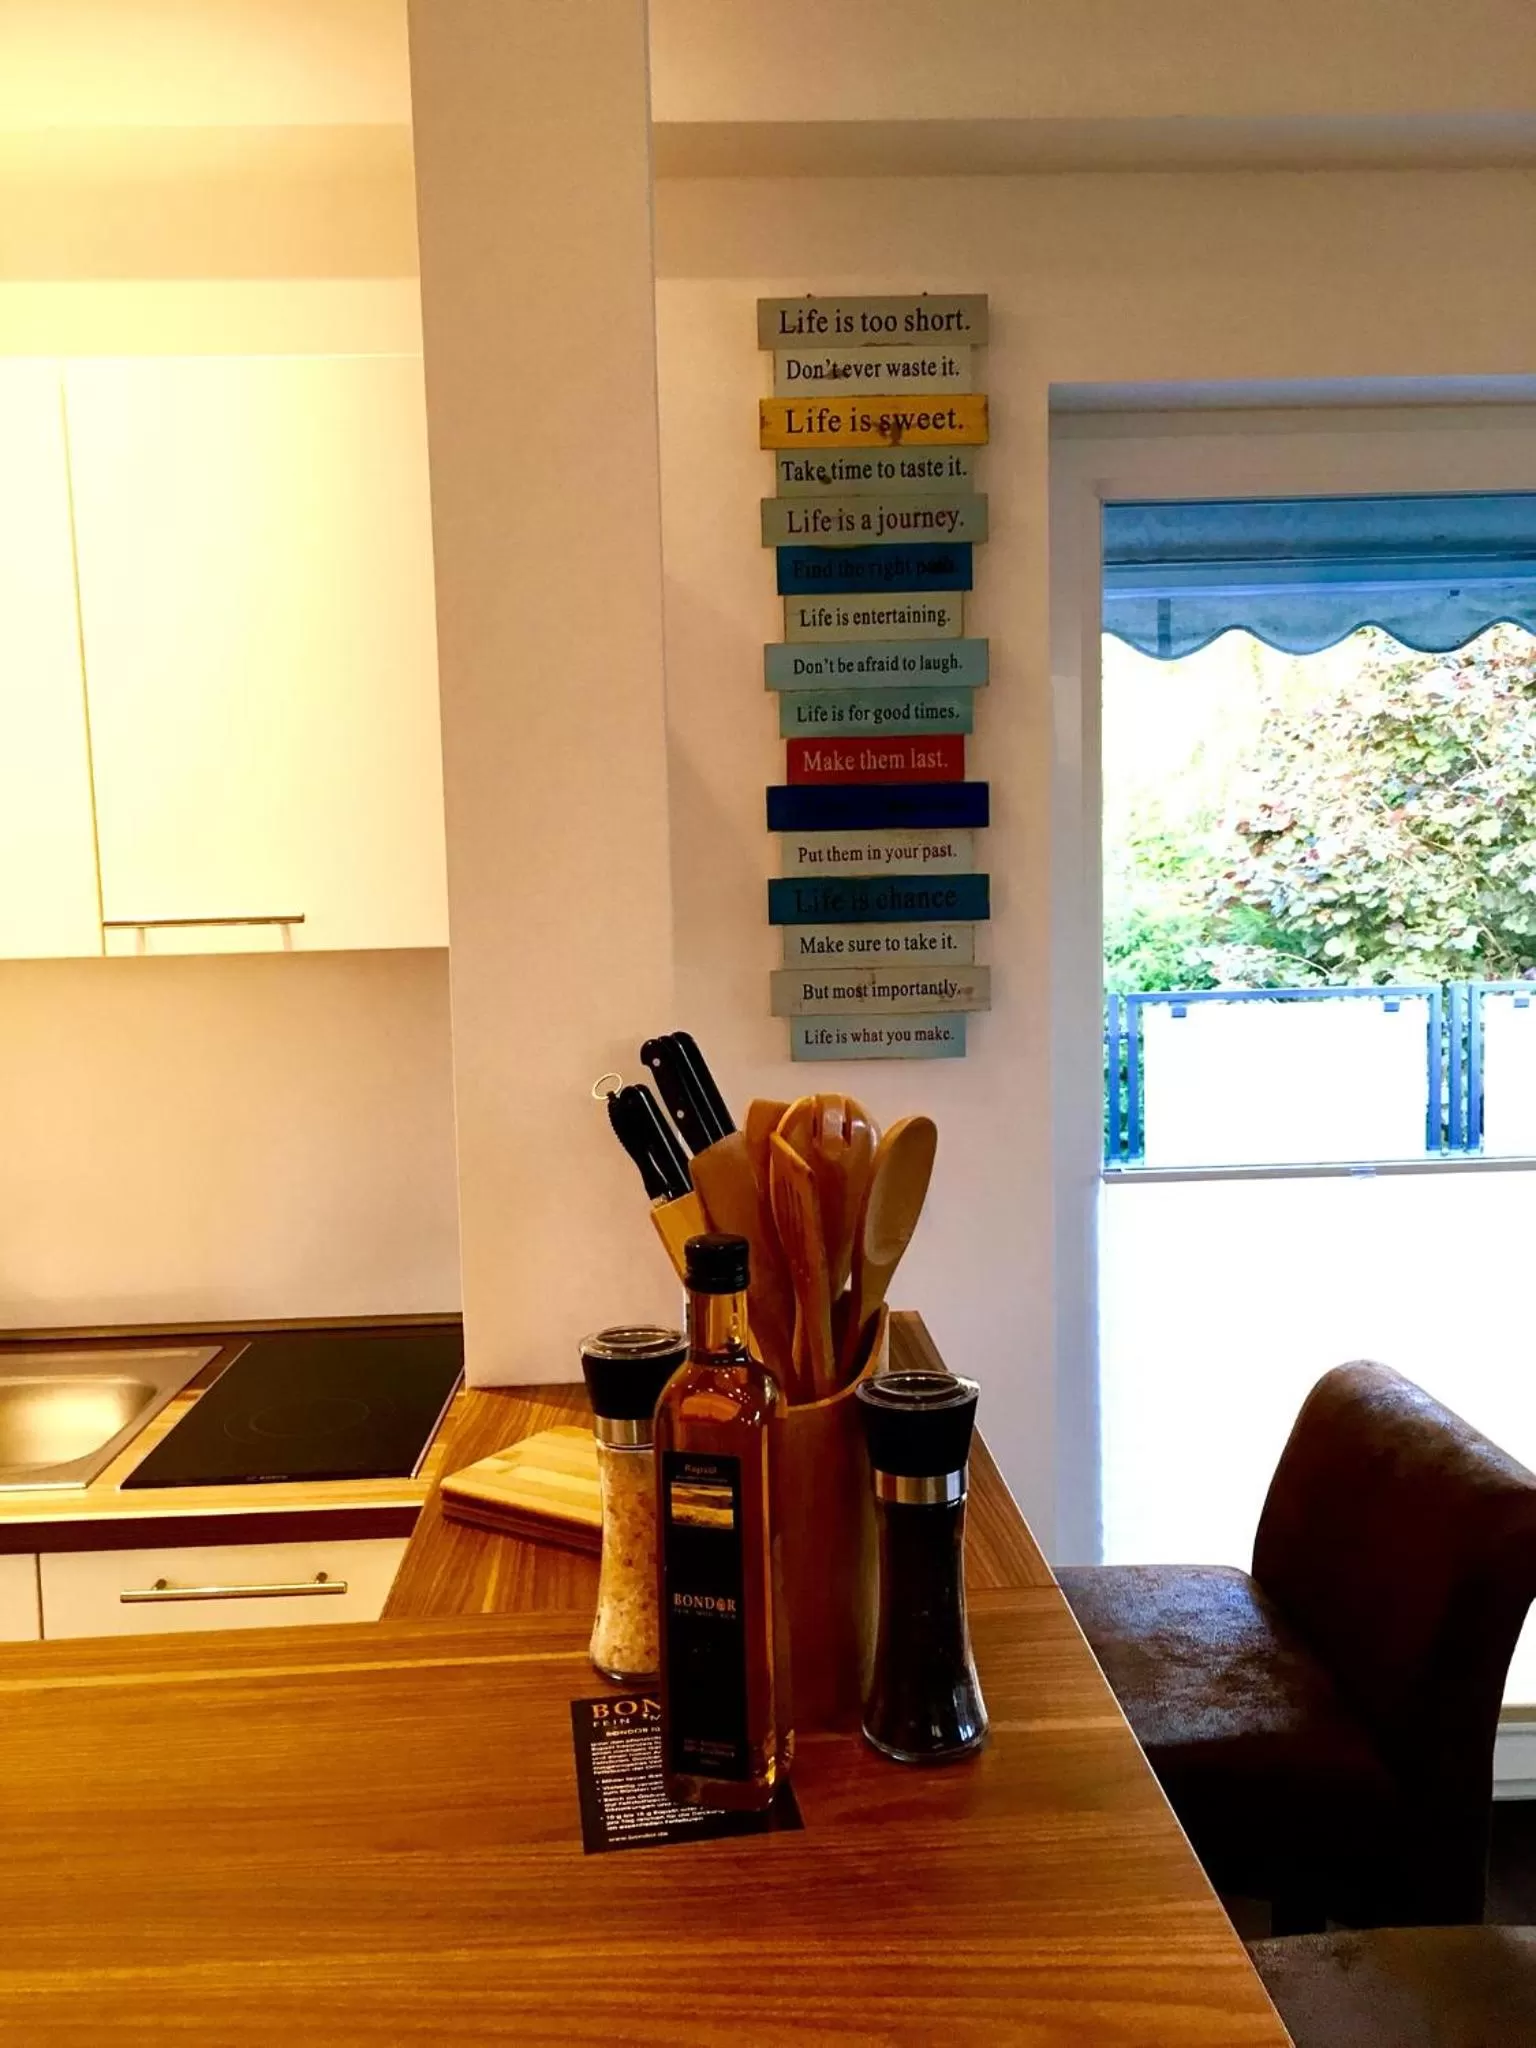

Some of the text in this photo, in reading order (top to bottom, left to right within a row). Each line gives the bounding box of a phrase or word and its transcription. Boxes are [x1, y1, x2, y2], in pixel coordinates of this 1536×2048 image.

[779, 308, 971, 334] Life is too short.
[787, 356, 960, 380] Don't ever waste it.
[786, 407, 964, 433] Life is sweet.
[781, 456, 967, 481] Take time to taste it.
[787, 507, 964, 536] Life is a journey.
[792, 559, 832, 579] Find
[839, 559, 864, 577] the
[800, 605, 951, 627] Life is entertaining.
[793, 652, 963, 675] Don't be afraid to laugh.
[796, 703, 960, 724] Life is for good times.
[803, 748, 949, 772] Make them last.
[798, 844, 957, 864] Put them in your past.
[794, 889, 844, 913] Life
[852, 890, 870, 911] is
[800, 933, 957, 954] Make sure to take it.
[803, 983, 828, 1000] But
[833, 983, 868, 998] most
[804, 1026, 954, 1046] Life is what you make.
